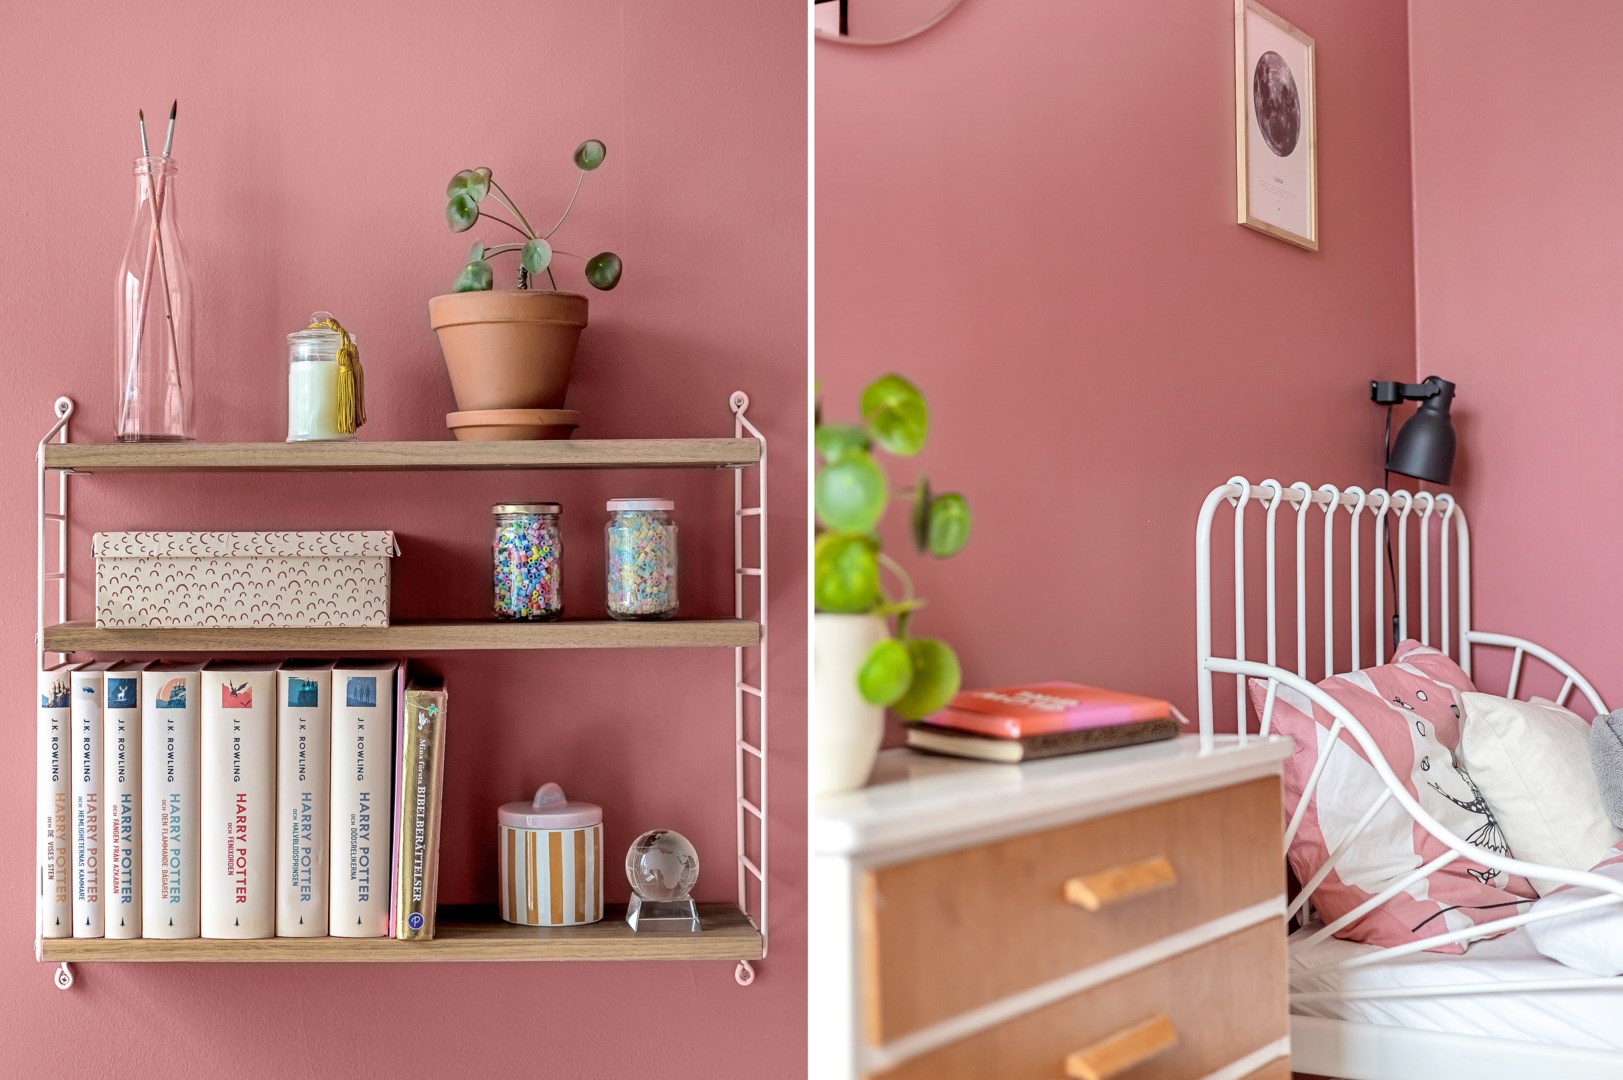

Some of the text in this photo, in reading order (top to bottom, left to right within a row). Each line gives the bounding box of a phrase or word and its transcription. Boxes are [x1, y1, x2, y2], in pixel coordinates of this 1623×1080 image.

[51, 718, 59, 782] J.K. ROWLING
[83, 737, 91, 783] ROWLING
[417, 761, 425, 785] första
[47, 829, 54, 838] DE
[55, 792, 67, 903] HARRY POTTER
[86, 793, 98, 903] HARRY POTTER
[112, 864, 120, 894] AZKABAN
[121, 793, 132, 904] HARRY POTTER
[170, 793, 181, 904] HARRY POTTER
[236, 793, 247, 904] HARRY POTTER
[300, 792, 312, 902] HARRY POTTER
[350, 827, 358, 881] DÖDSRELIKERNA
[358, 792, 370, 902] HARRY POTTER
[412, 786, 426, 902] BIBELBERÄTTELSER
